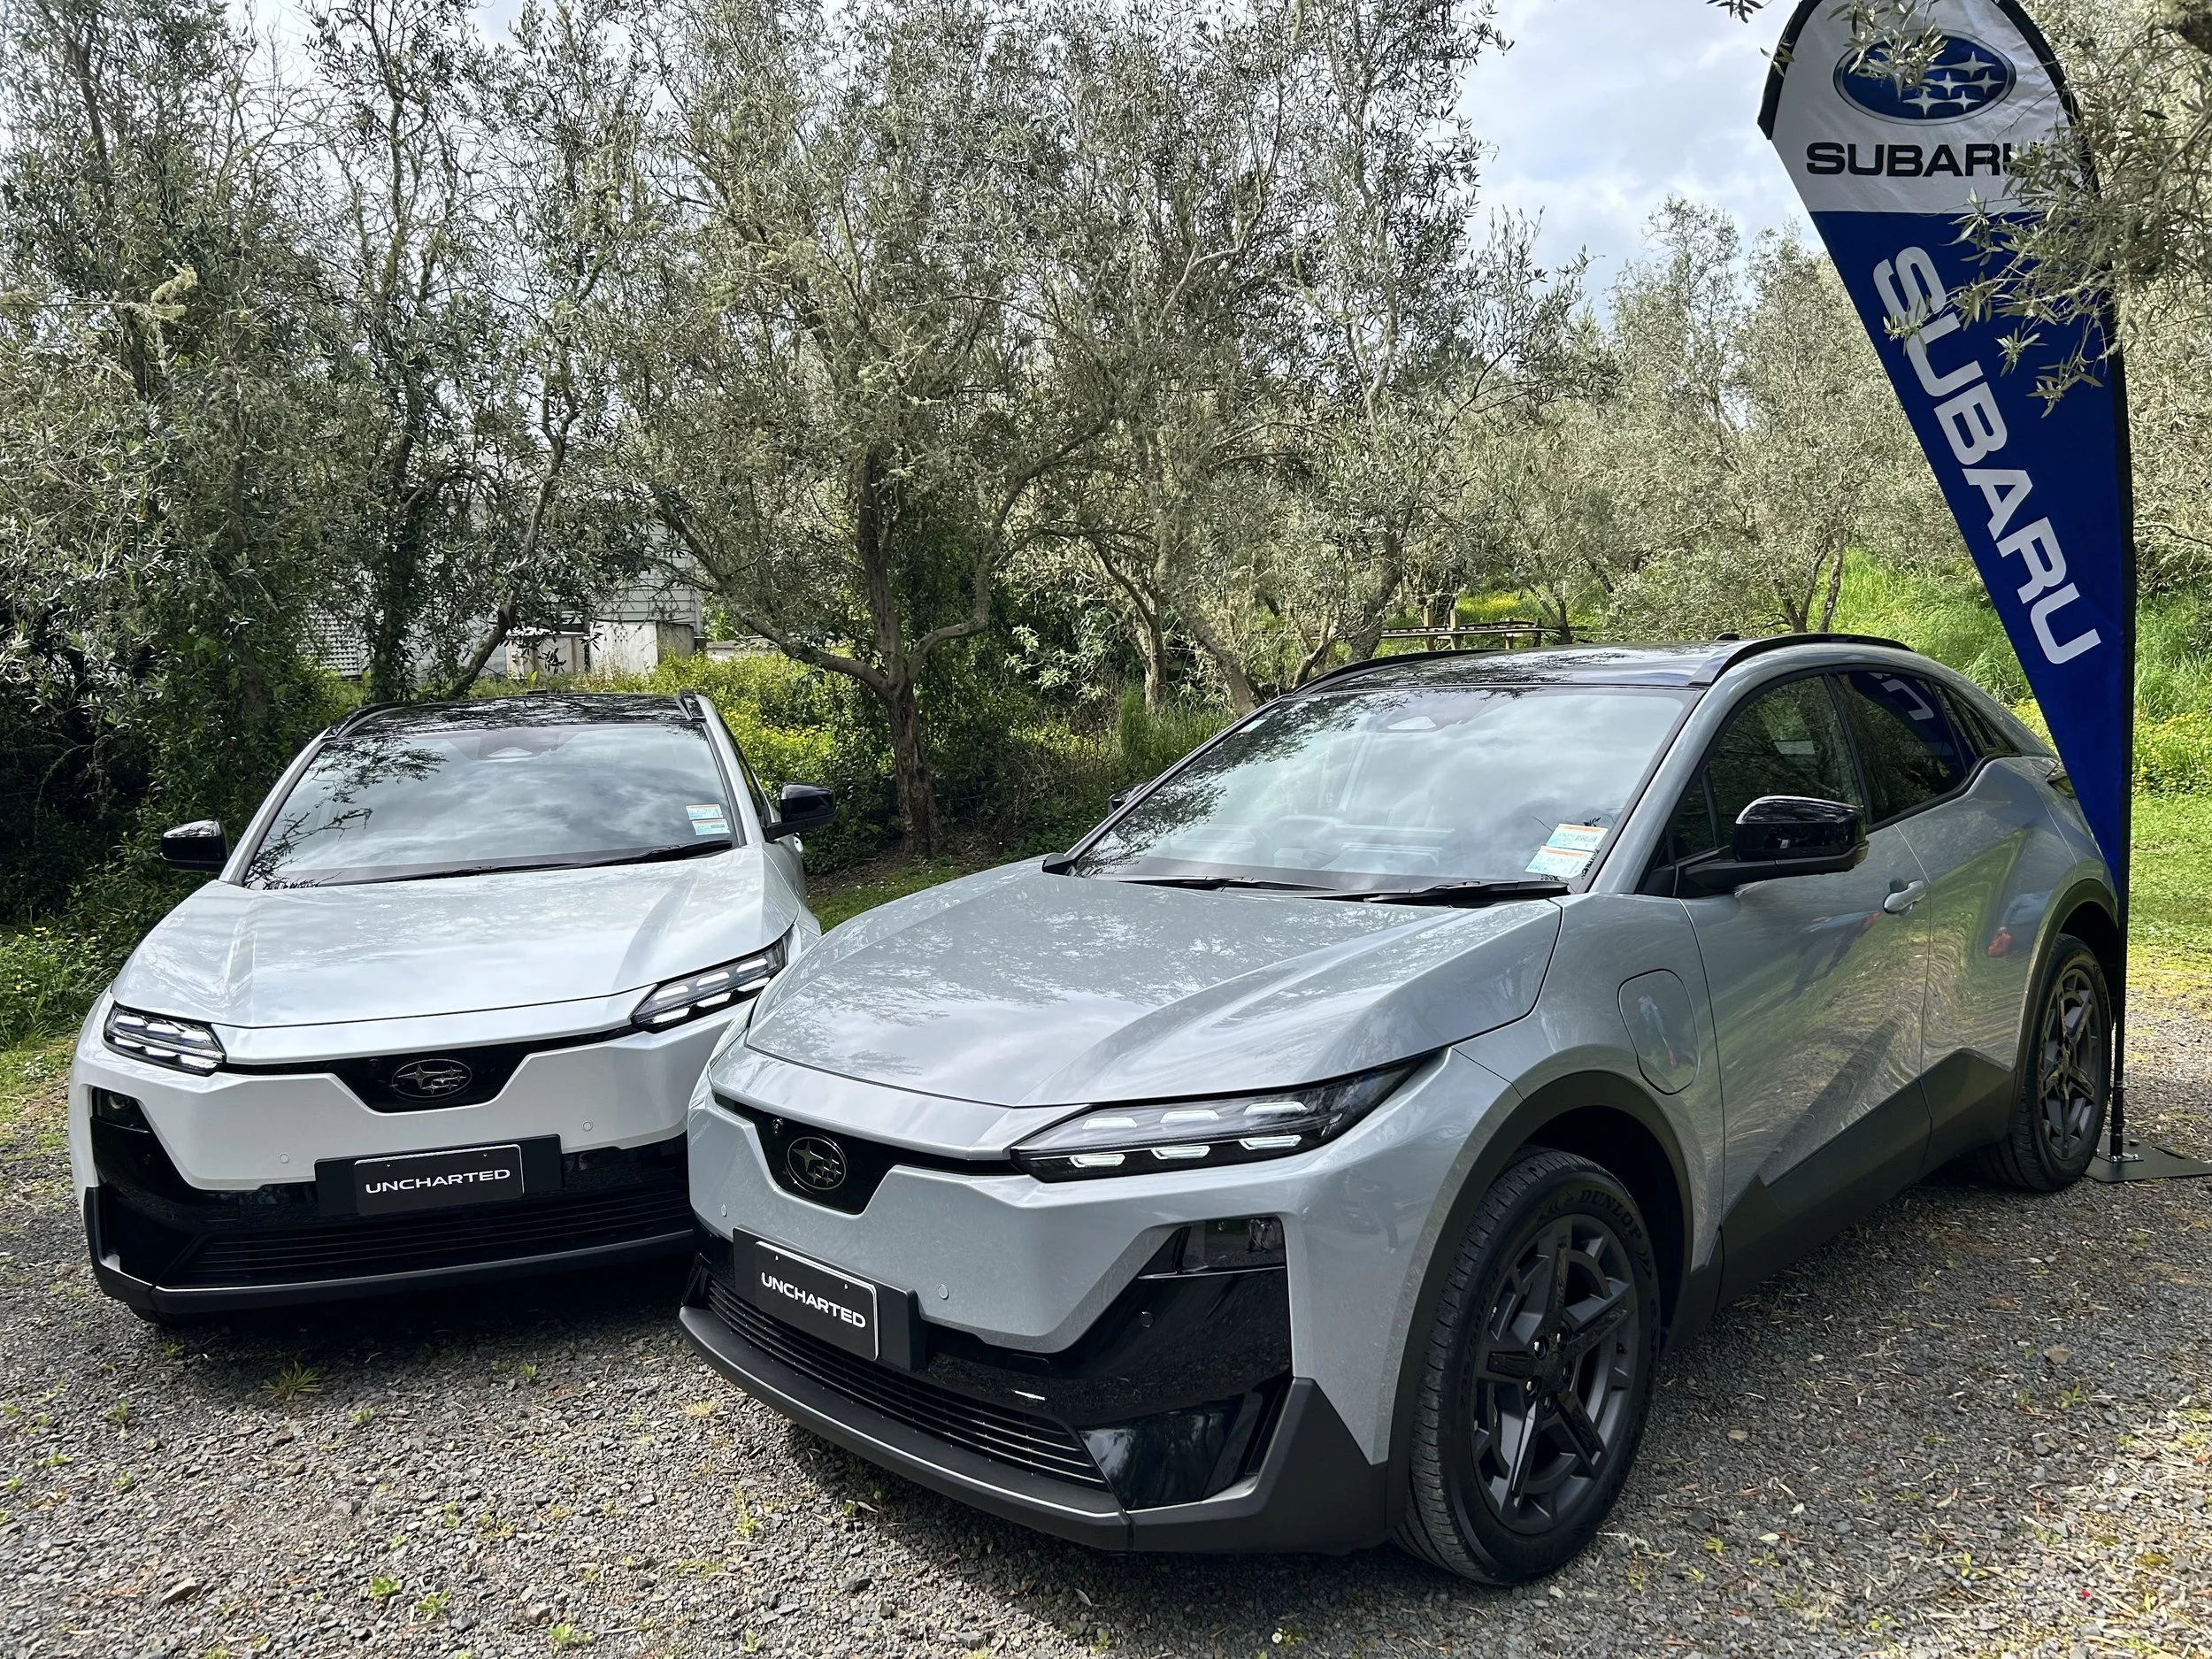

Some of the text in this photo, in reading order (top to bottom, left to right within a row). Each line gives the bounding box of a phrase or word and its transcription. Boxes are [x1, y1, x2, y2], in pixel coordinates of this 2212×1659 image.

[1872, 246, 2101, 664] SUBARU
[365, 1169, 511, 1194] UNCHARTED
[1578, 1189, 1643, 1239] DUNLOP
[761, 1272, 866, 1328] UNCHARTED
